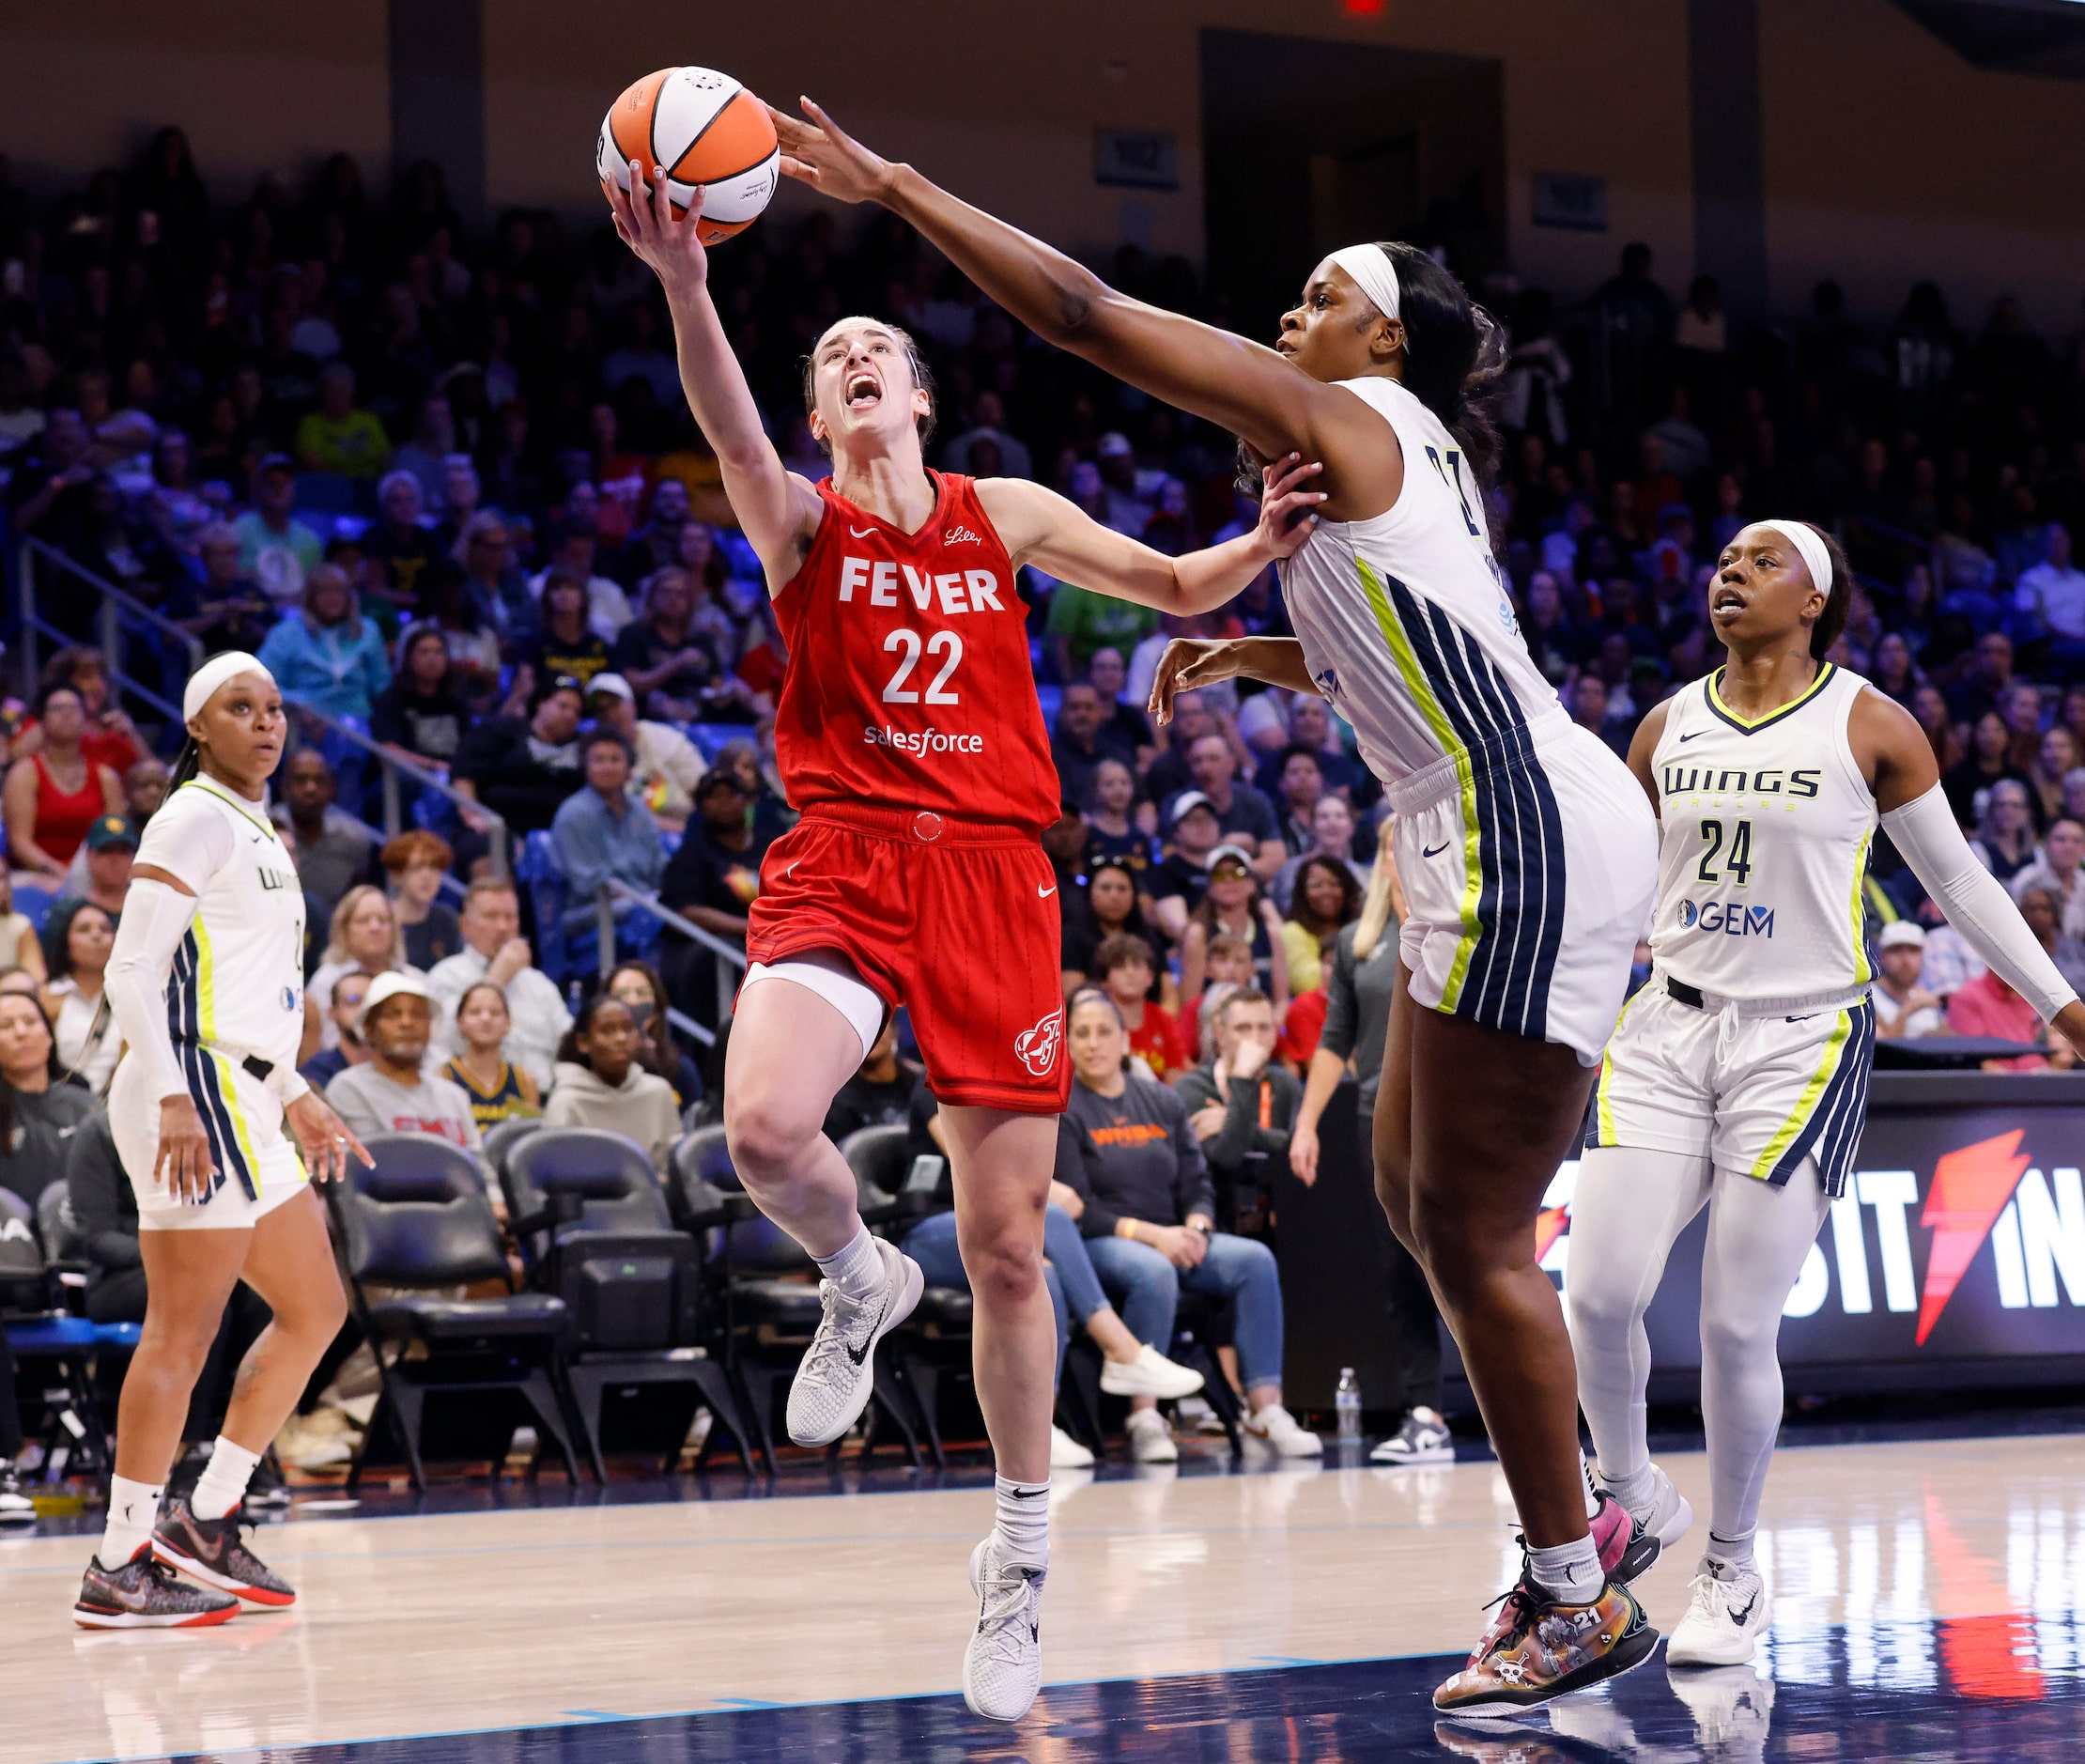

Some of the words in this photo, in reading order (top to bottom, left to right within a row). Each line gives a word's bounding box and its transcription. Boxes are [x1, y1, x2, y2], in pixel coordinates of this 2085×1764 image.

[944, 525, 982, 547] Lilly
[838, 555, 1006, 615] FEVER
[882, 627, 964, 705] 22
[863, 724, 983, 758] salesforce
[1697, 817, 1754, 887] 24
[1698, 901, 1774, 938] GEM
[1573, 1607, 1601, 1630] 21
